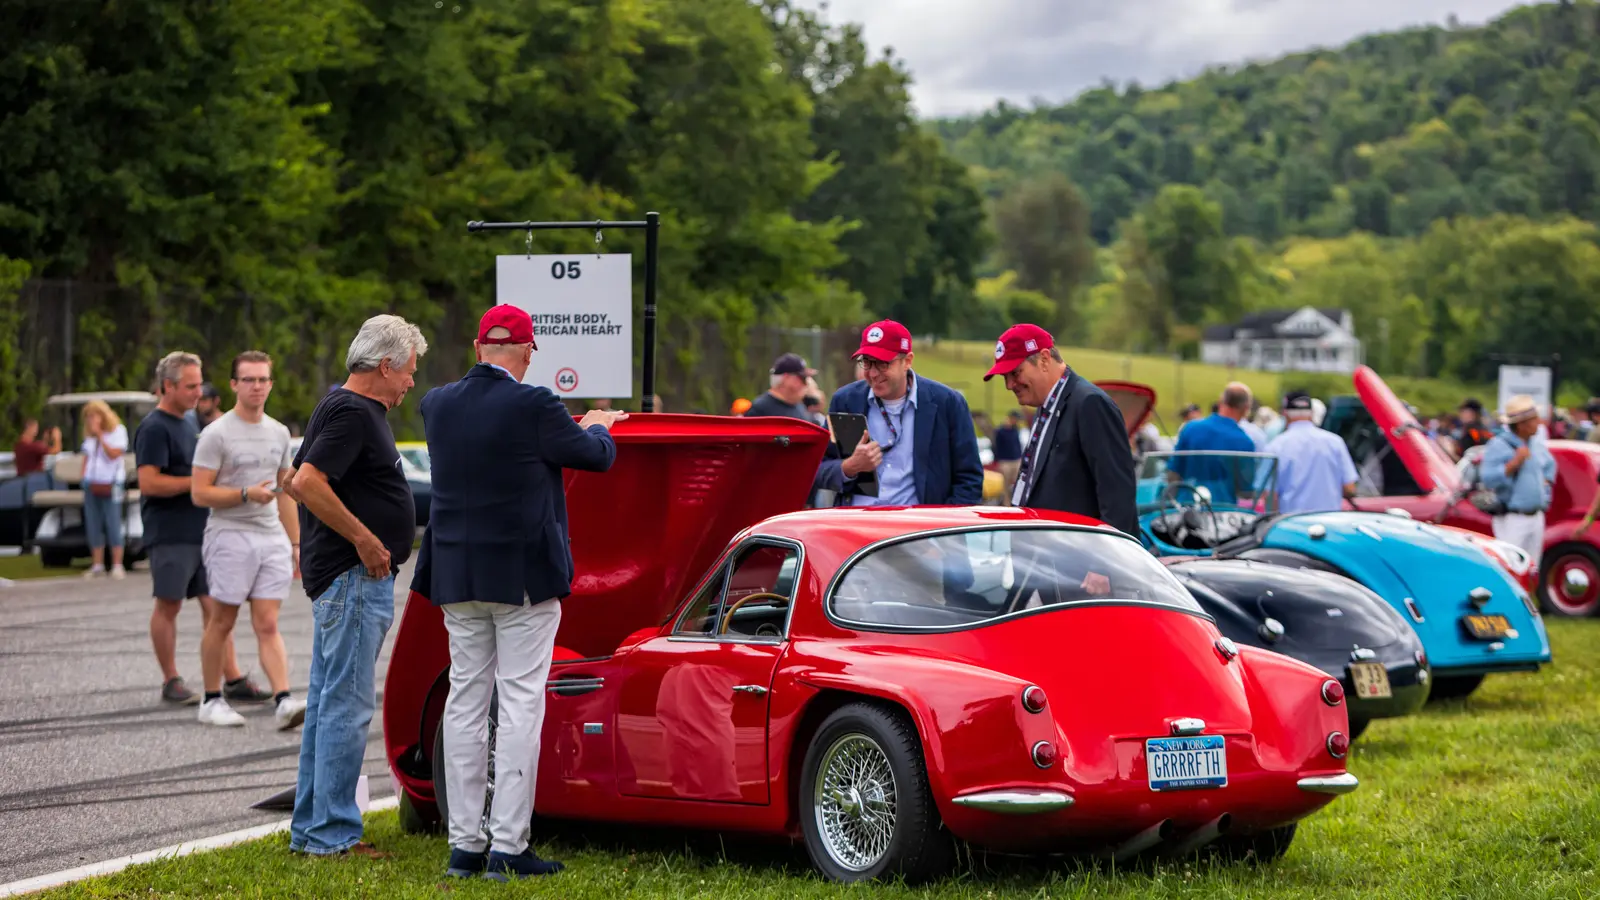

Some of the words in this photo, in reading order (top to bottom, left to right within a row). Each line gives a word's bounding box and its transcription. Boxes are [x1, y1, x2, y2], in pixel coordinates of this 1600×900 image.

[551, 261, 581, 279] 05
[531, 313, 571, 324] RITISH
[574, 313, 611, 325] BODY,
[533, 325, 578, 335] ERICAN
[582, 325, 622, 335] HEART
[559, 375, 575, 384] 44
[1166, 741, 1184, 751] NEW
[1185, 740, 1206, 750] YORK
[1154, 751, 1220, 778] GRRRRFTH
